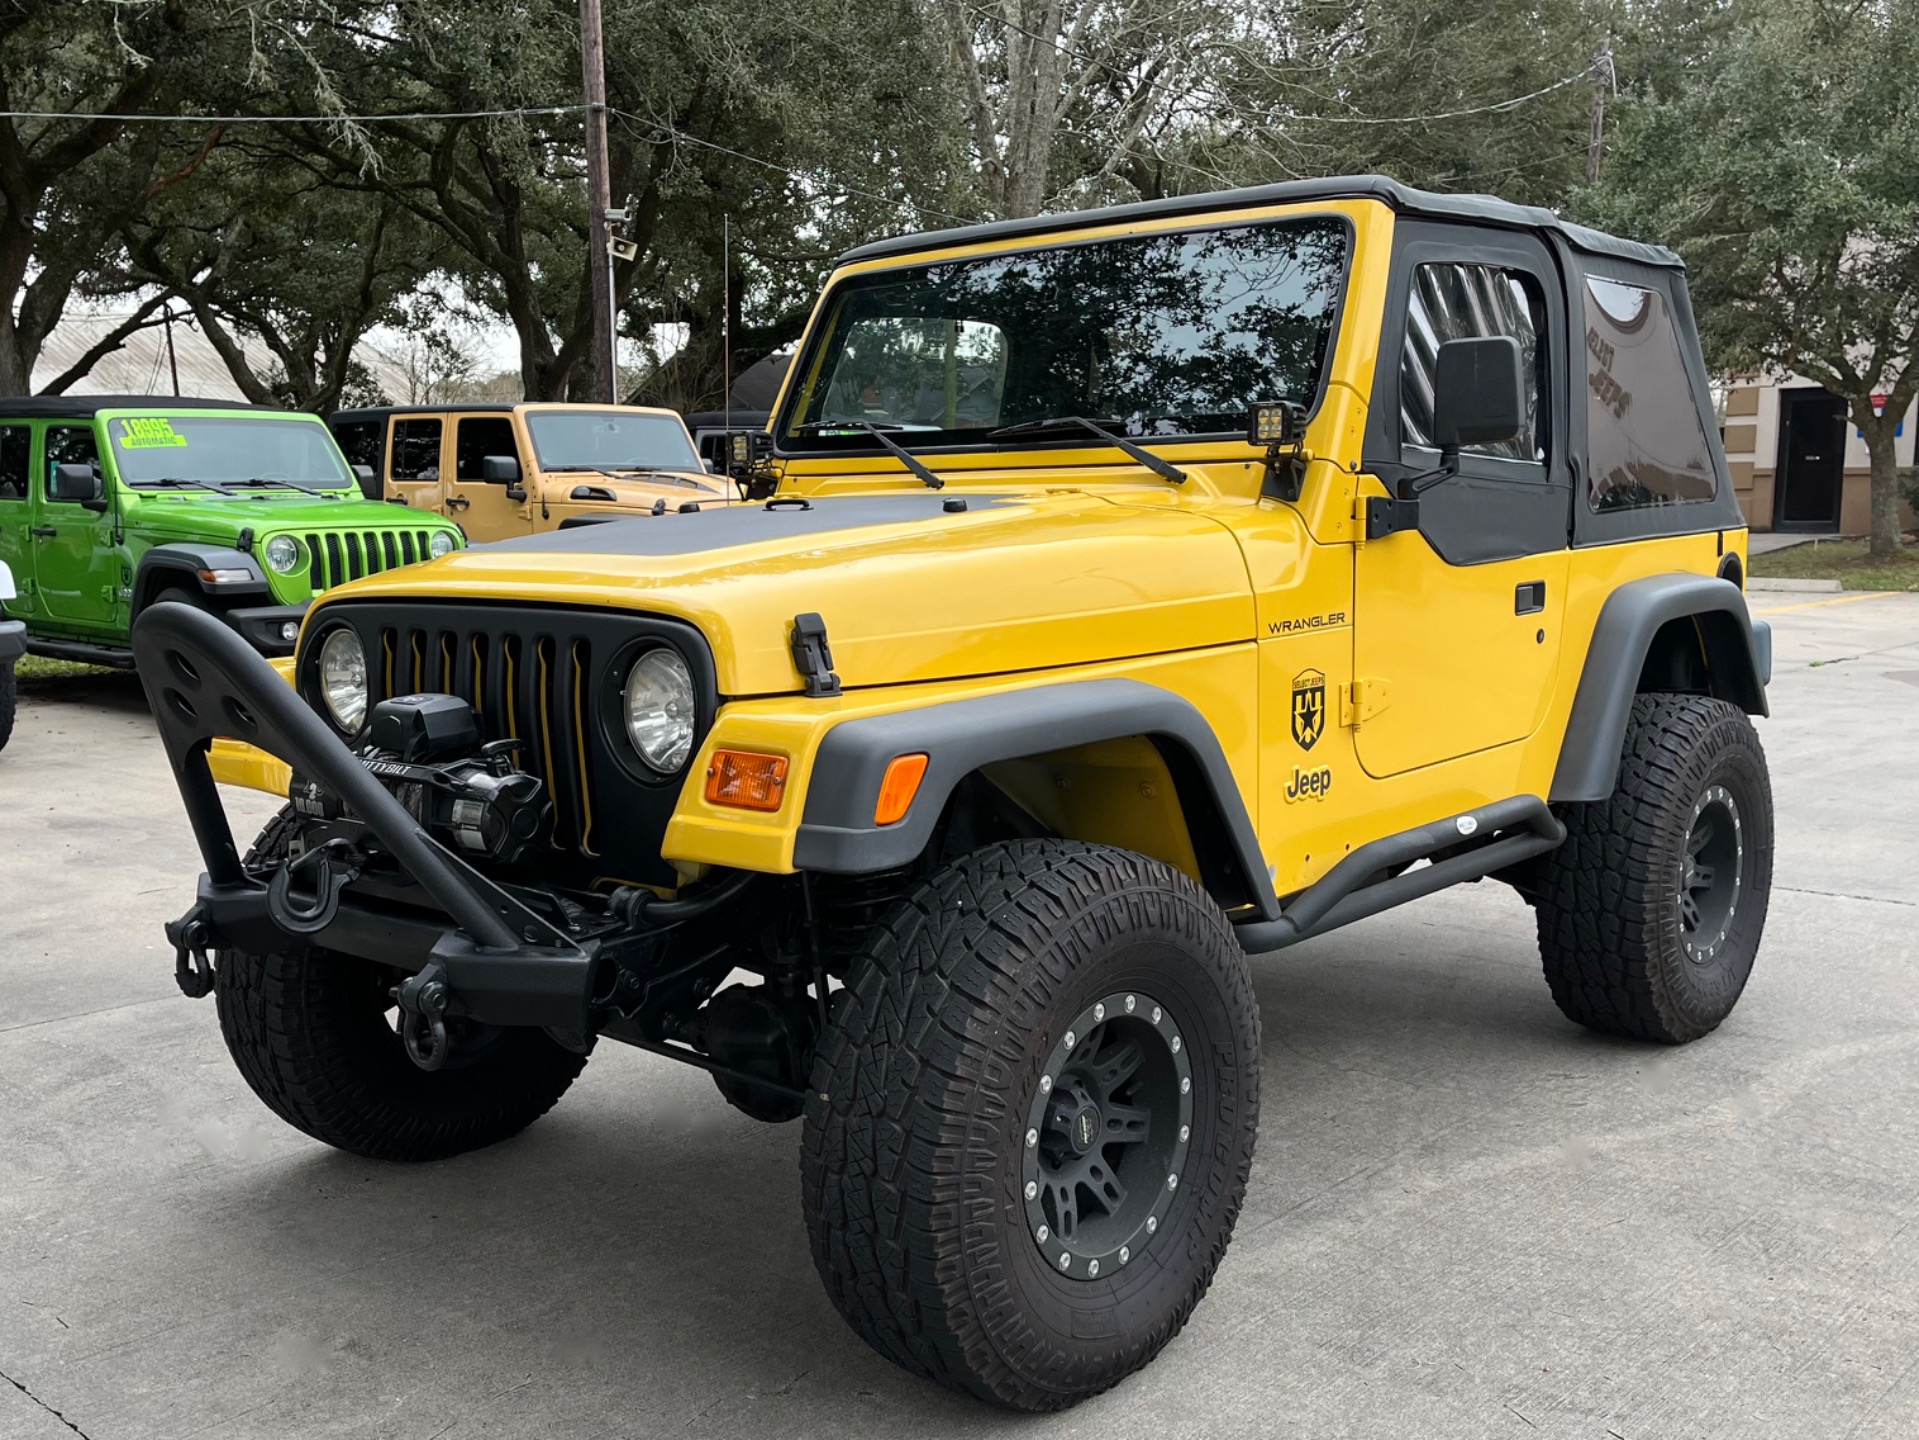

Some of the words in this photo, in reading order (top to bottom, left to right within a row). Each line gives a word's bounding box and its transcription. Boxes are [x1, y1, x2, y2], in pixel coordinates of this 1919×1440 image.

[120, 418, 175, 437] 18995
[131, 437, 177, 446] AUTOMATIC
[1268, 612, 1346, 634] WRANGLER
[1286, 767, 1331, 799] Jeep
